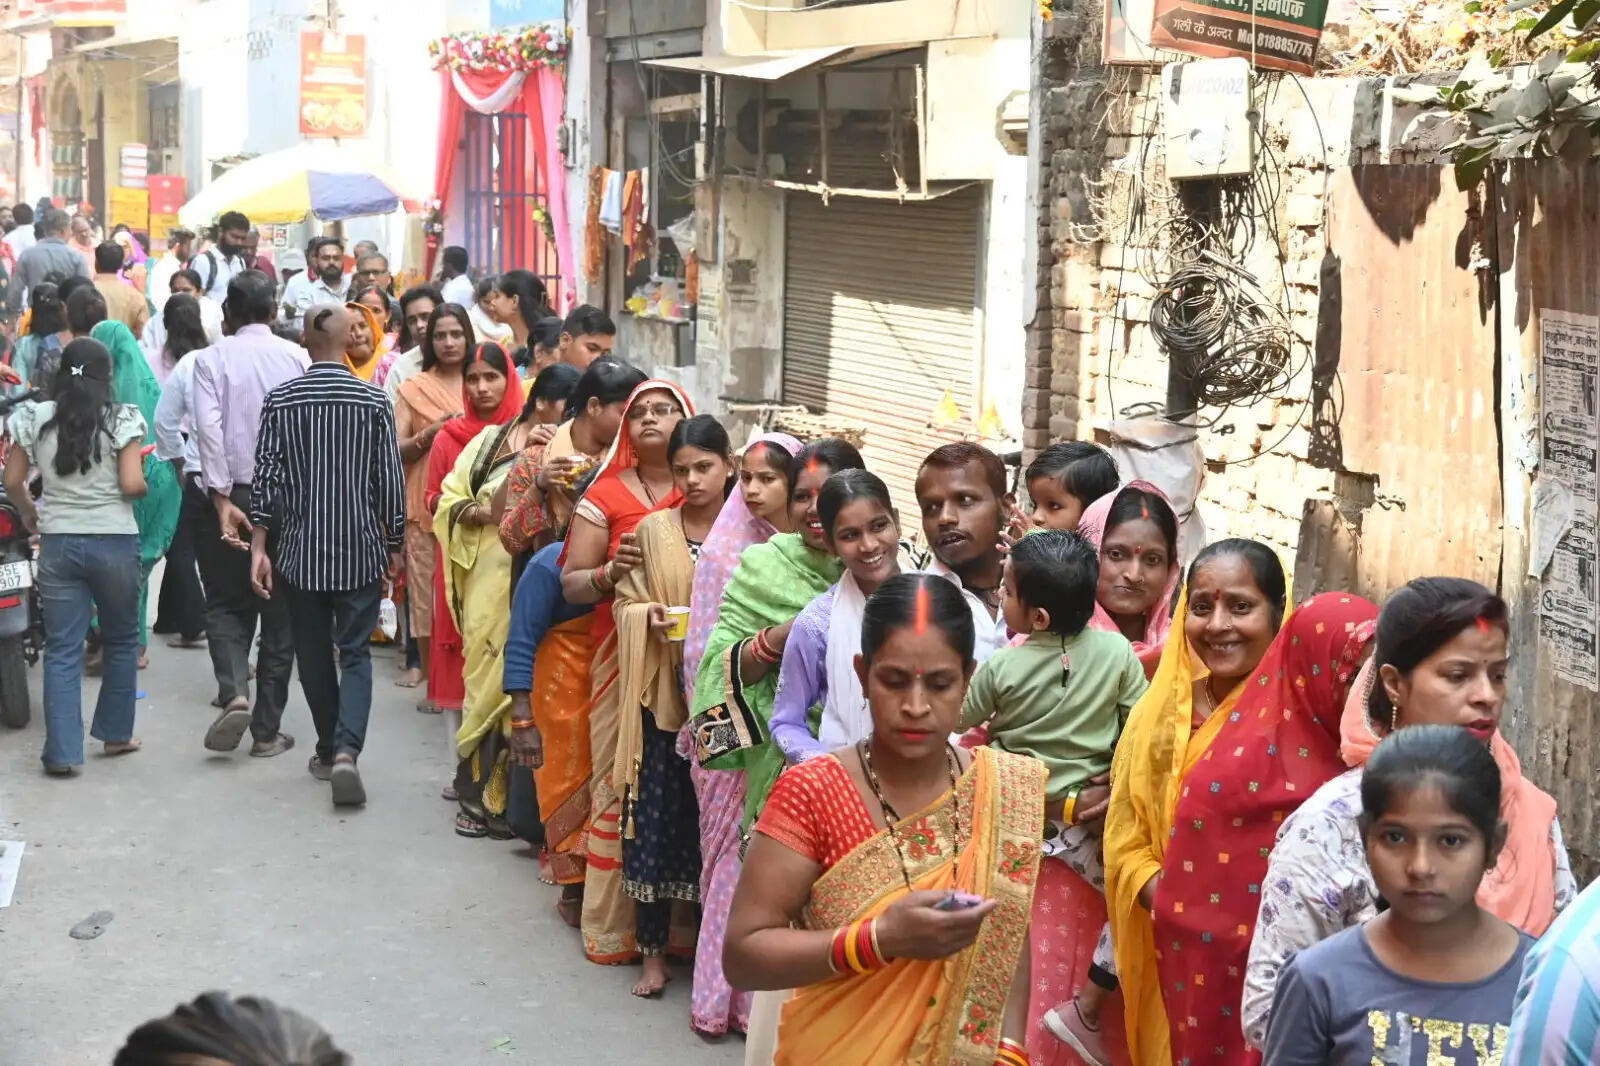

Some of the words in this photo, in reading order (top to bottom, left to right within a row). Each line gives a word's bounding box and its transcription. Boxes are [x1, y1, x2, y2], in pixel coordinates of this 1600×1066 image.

[1173, 18, 1192, 33] गली
[1194, 21, 1206, 35] के
[1207, 25, 1233, 41] अन्दर
